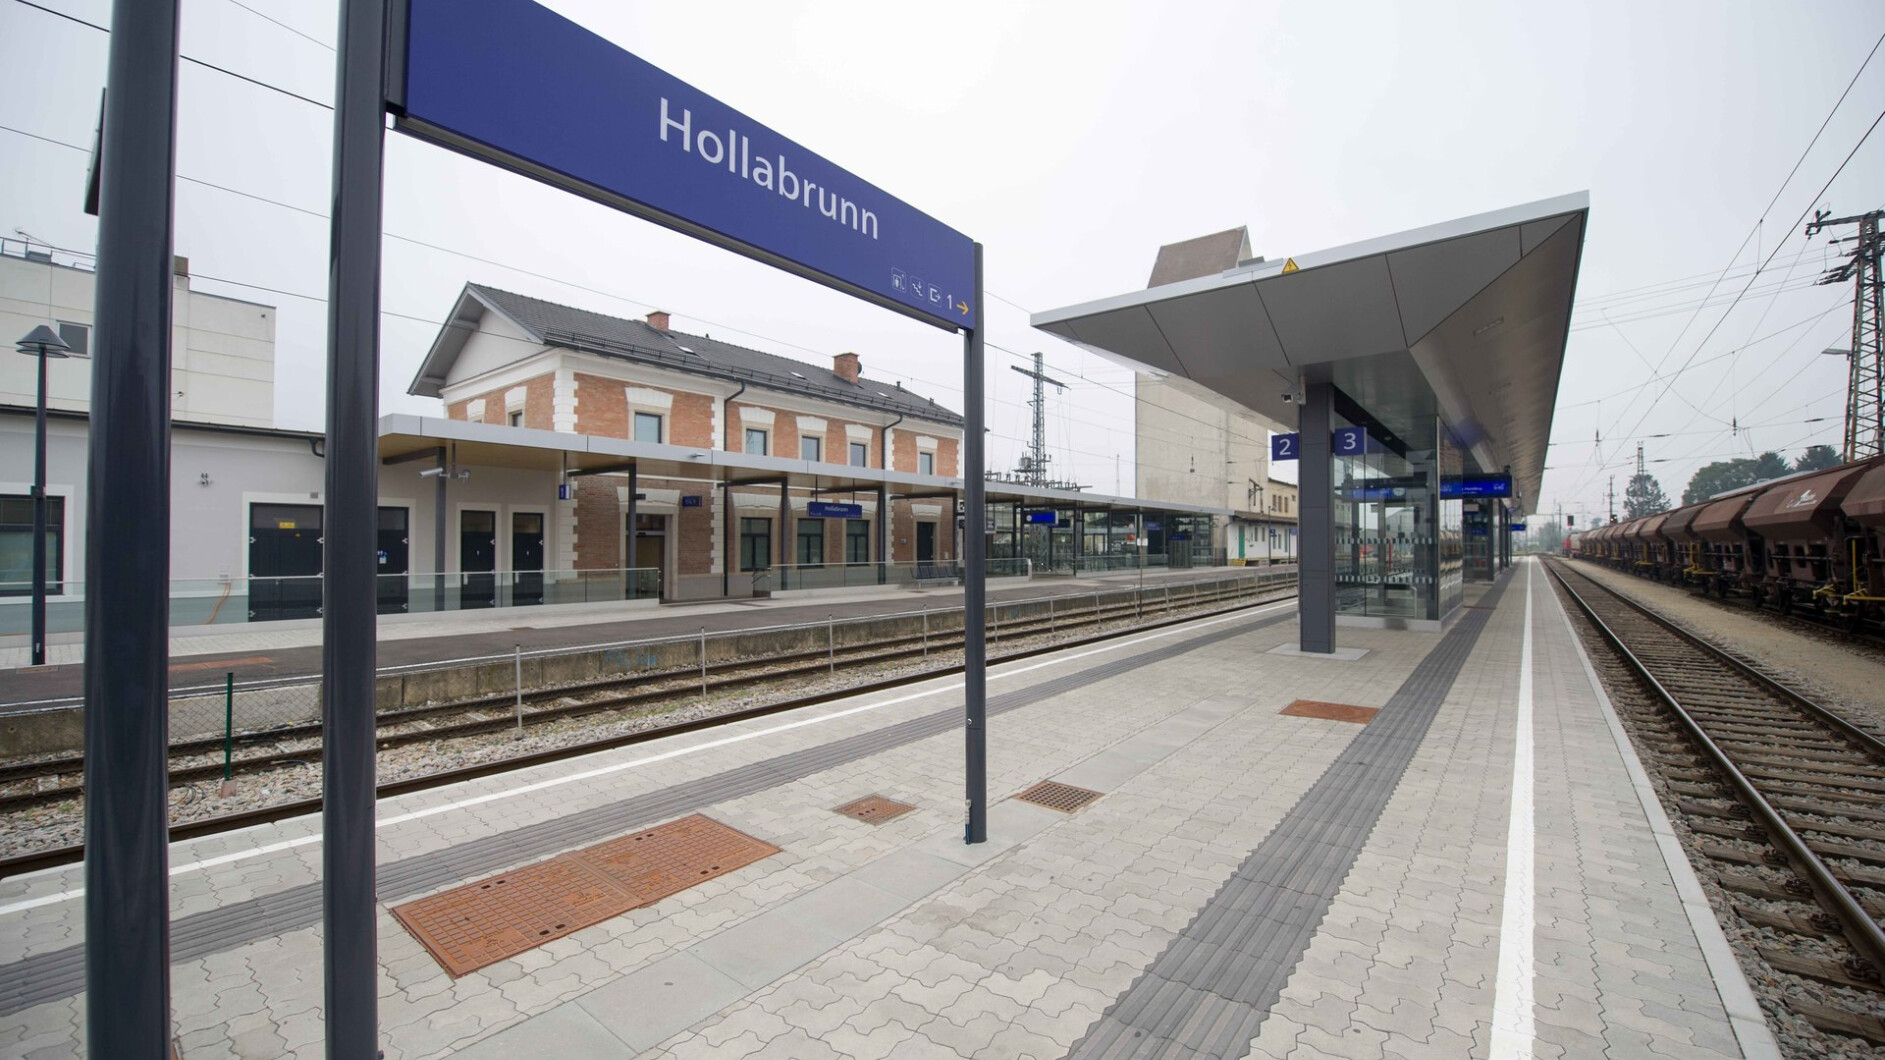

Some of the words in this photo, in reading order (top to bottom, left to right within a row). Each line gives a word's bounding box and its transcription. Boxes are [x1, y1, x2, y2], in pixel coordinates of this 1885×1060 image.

[660, 97, 879, 240] Hollabrunn
[946, 294, 953, 309] 1
[1279, 439, 1291, 455] 2
[1343, 433, 1357, 449] 3
